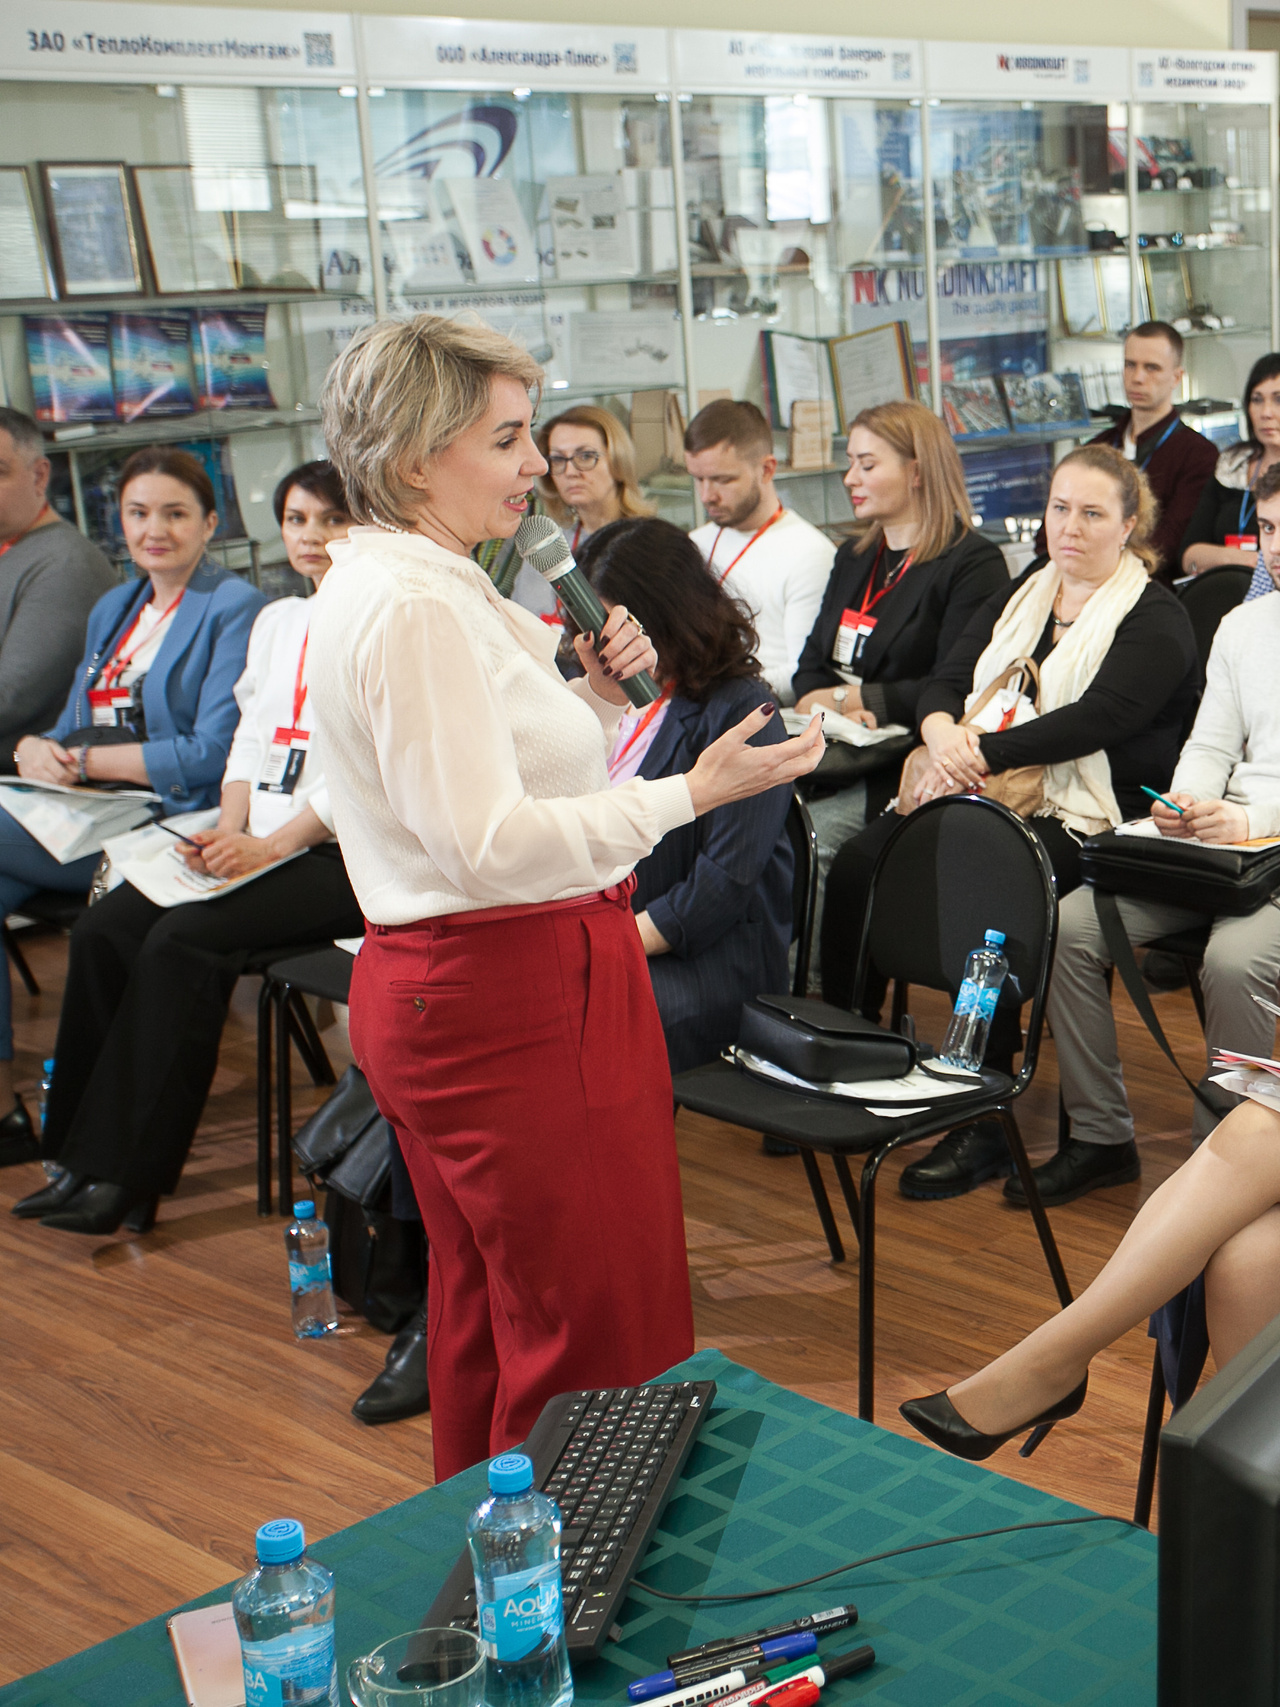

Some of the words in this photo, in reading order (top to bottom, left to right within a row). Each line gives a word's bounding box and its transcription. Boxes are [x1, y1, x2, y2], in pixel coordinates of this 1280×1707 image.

[28, 31, 65, 51] ЗАО
[503, 1583, 560, 1618] AQUA
[245, 1668, 268, 1692] ВА
